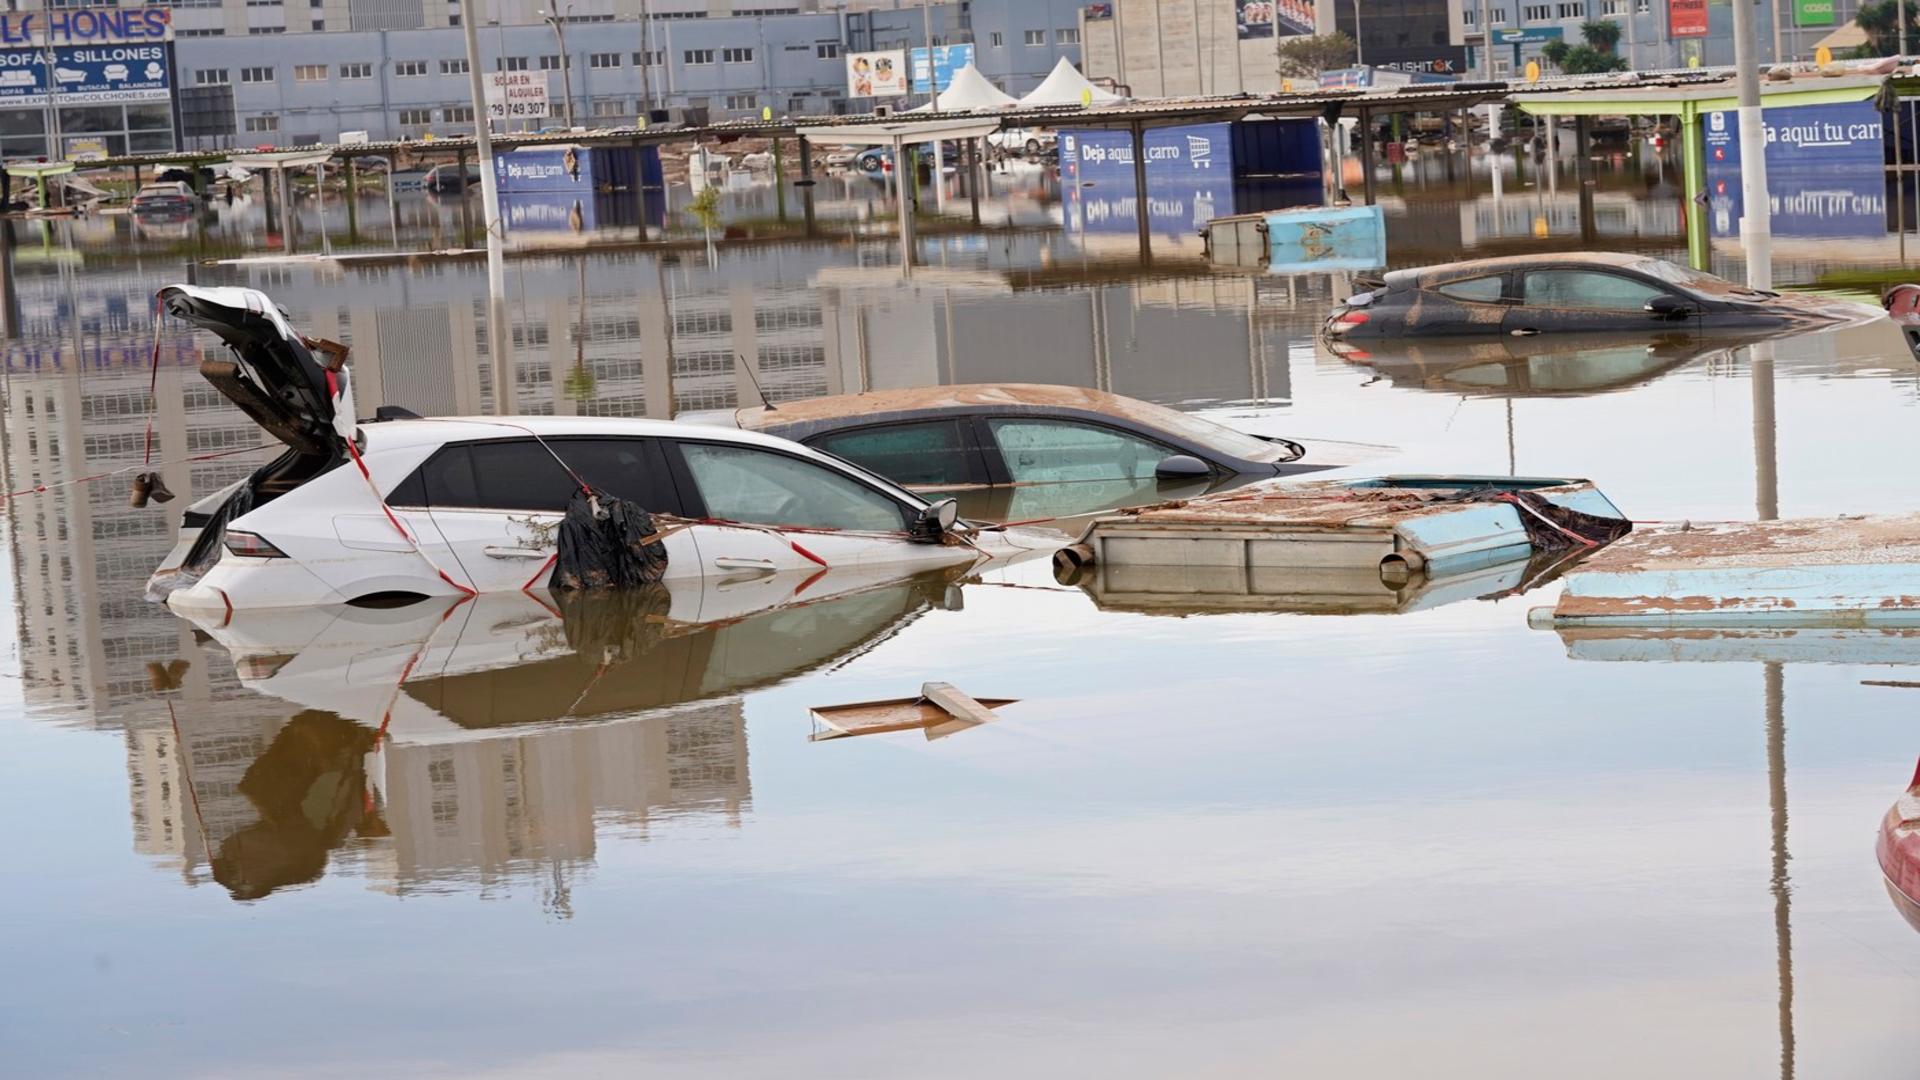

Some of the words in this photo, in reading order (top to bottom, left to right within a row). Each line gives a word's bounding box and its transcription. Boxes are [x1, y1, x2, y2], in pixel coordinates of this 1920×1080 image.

[73, 47, 163, 64] SILLONES
[494, 75, 519, 86] SOLAR
[520, 75, 531, 85] EN
[509, 87, 544, 98] ALQUILER
[487, 103, 505, 116] 29
[527, 102, 546, 114] 307
[1780, 121, 1820, 147] aquí
[1824, 122, 1844, 141] tu
[1082, 144, 1106, 165] Deja
[1148, 146, 1180, 160] carro
